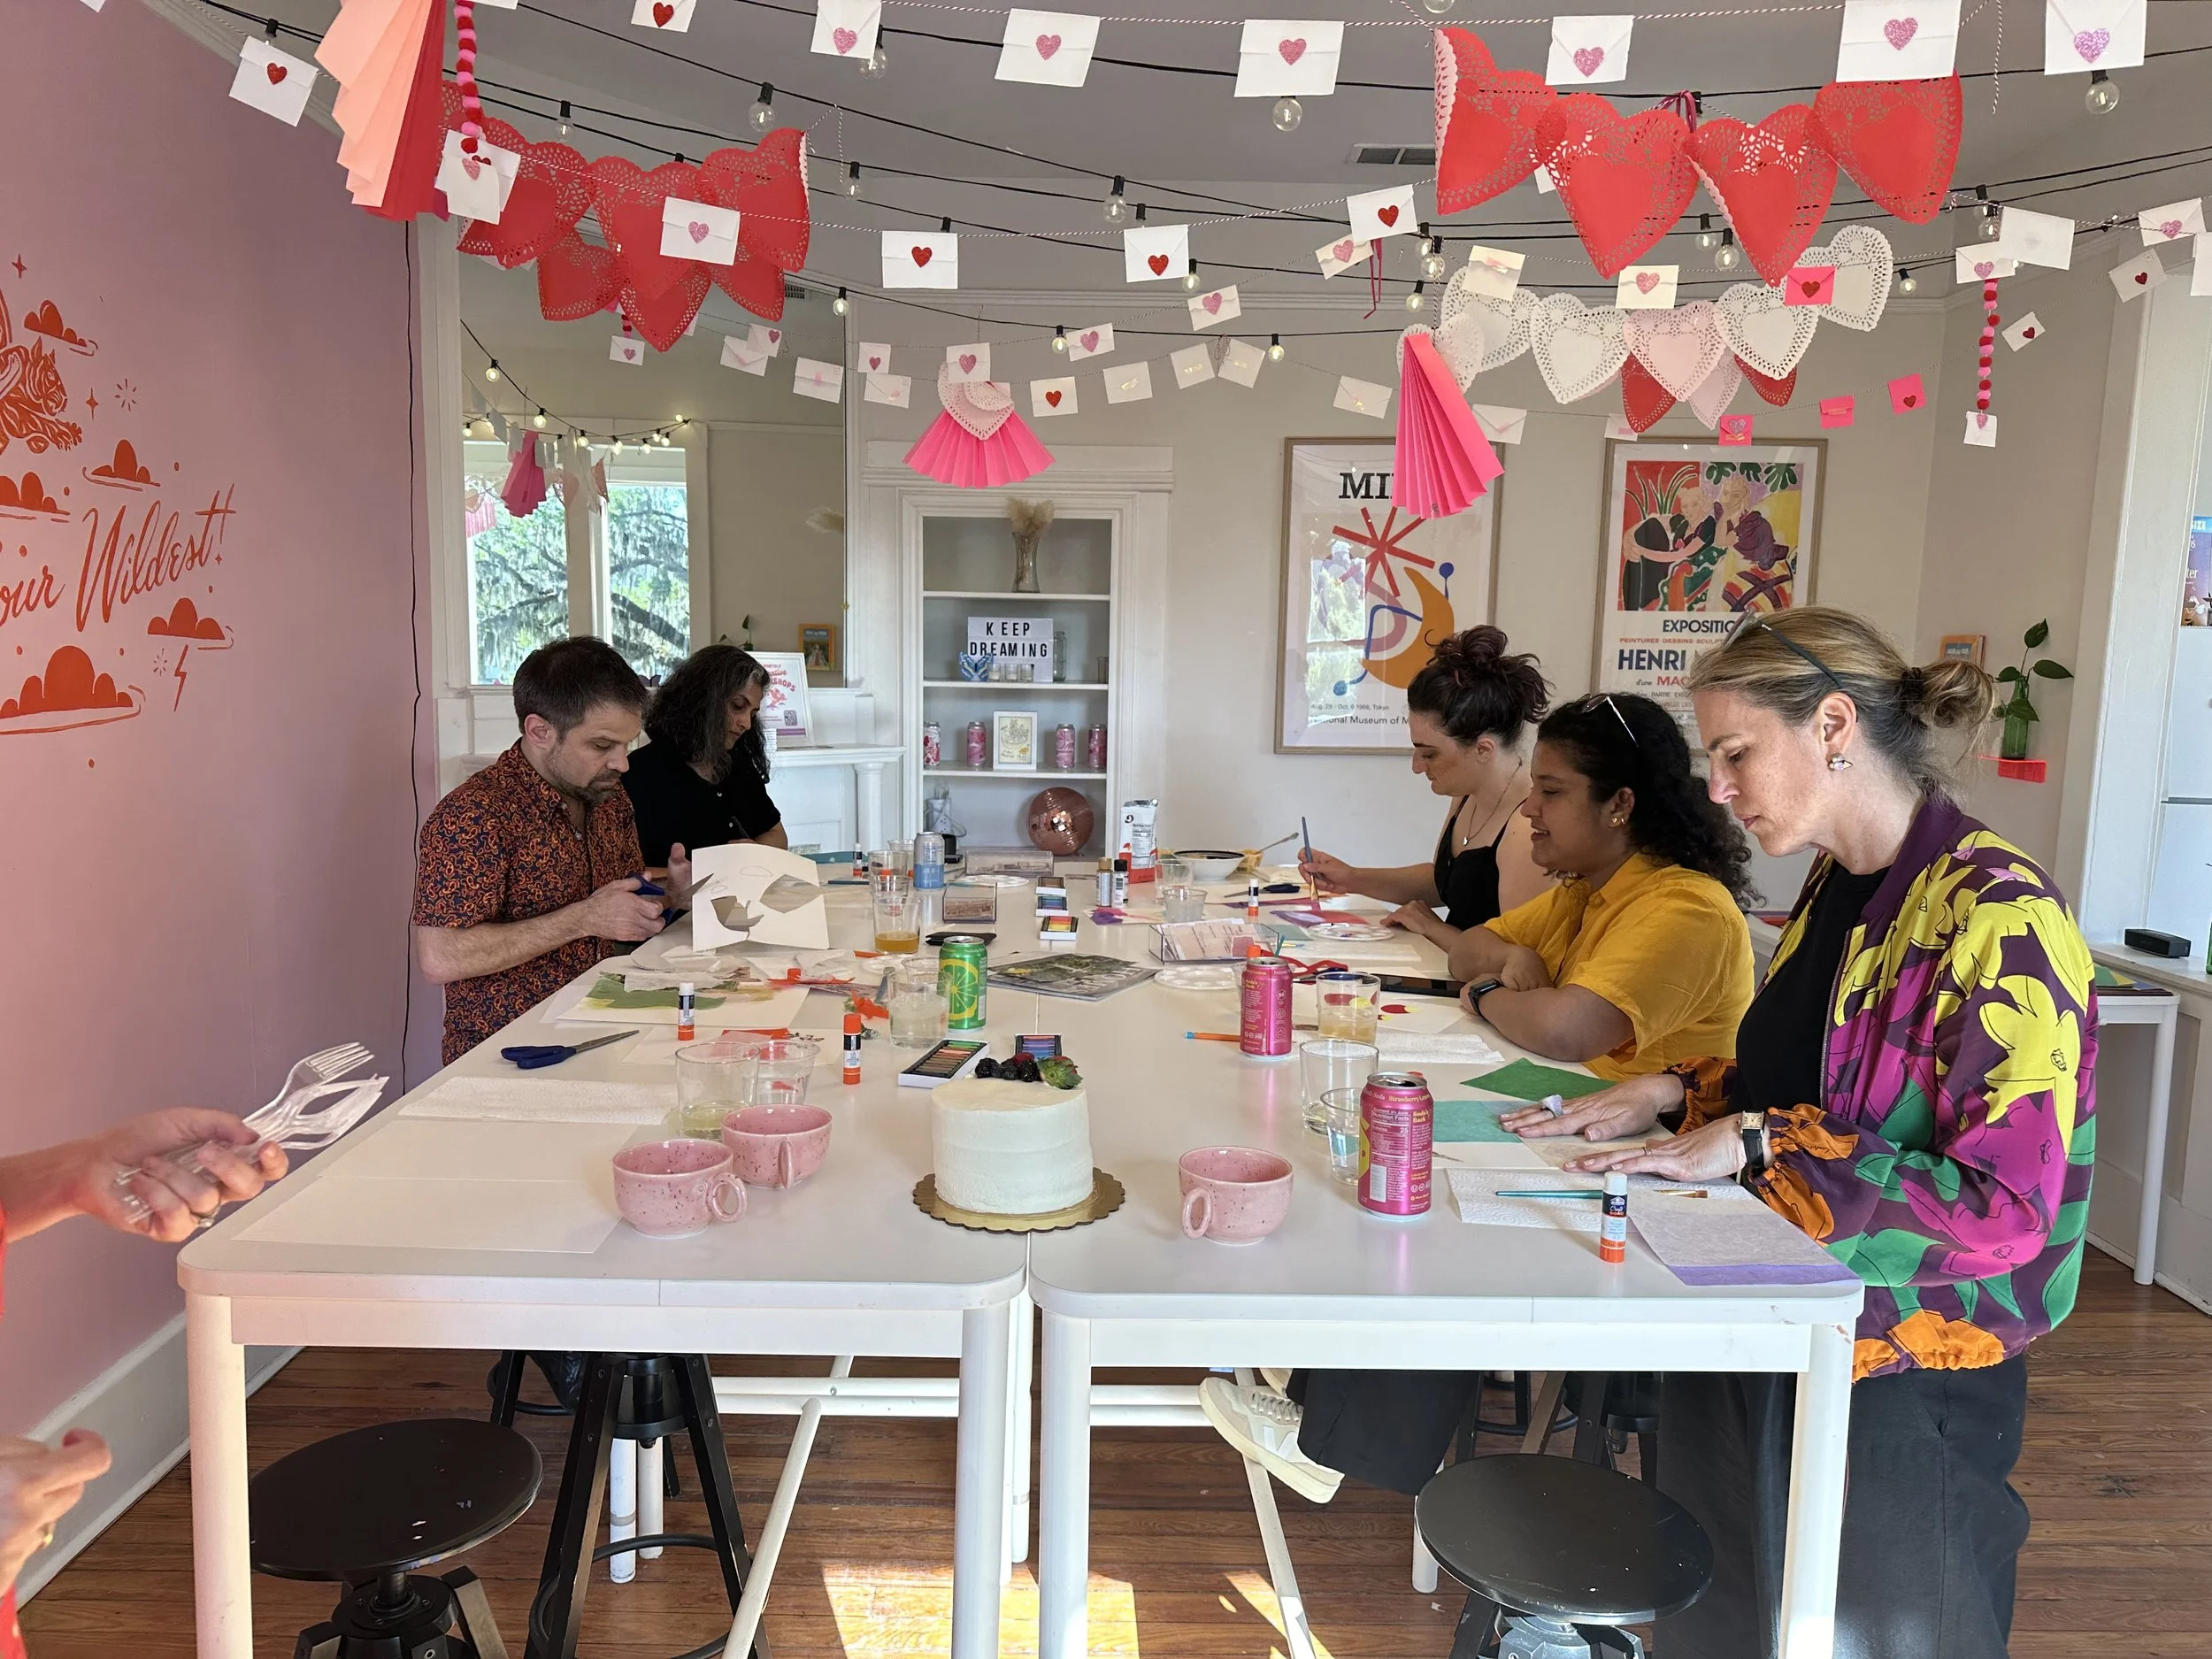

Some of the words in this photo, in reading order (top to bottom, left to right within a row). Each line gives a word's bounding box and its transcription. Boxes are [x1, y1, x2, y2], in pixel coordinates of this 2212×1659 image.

[1339, 472, 1394, 499] MI
[987, 622, 1030, 636] KEEP
[970, 641, 1048, 657] DREAMING
[1618, 649, 1686, 671] HENRI
